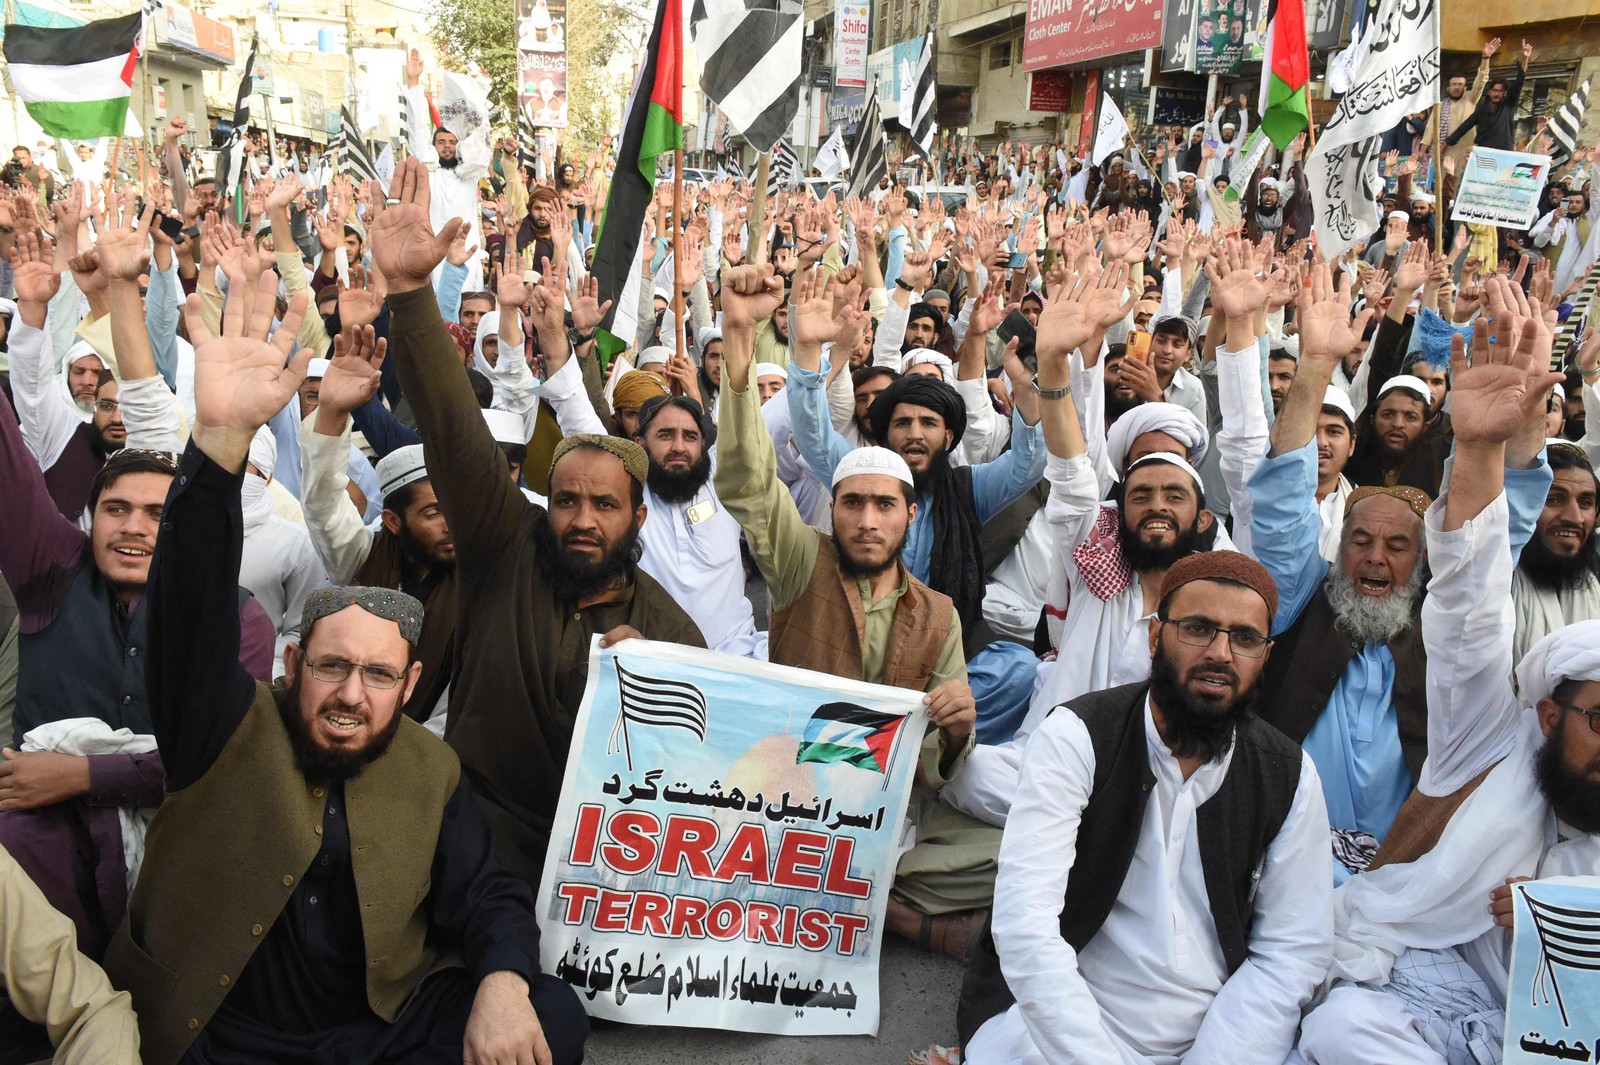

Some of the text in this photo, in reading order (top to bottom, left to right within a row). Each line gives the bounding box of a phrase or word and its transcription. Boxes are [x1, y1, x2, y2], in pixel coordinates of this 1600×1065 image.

[842, 18, 867, 34] Shifa
[842, 37, 866, 46] Facilitation
[1029, 26, 1046, 41] Cloth
[1047, 21, 1072, 37] Center
[844, 56, 861, 65] Quetta
[845, 47, 861, 56] Center
[602, 769, 664, 805] گرد
[764, 796, 886, 832] اسرائیل
[569, 804, 872, 899] ISRAEL
[558, 883, 871, 956] TERRORIST
[617, 952, 667, 1008] ضلع
[667, 953, 730, 1014] اسلام
